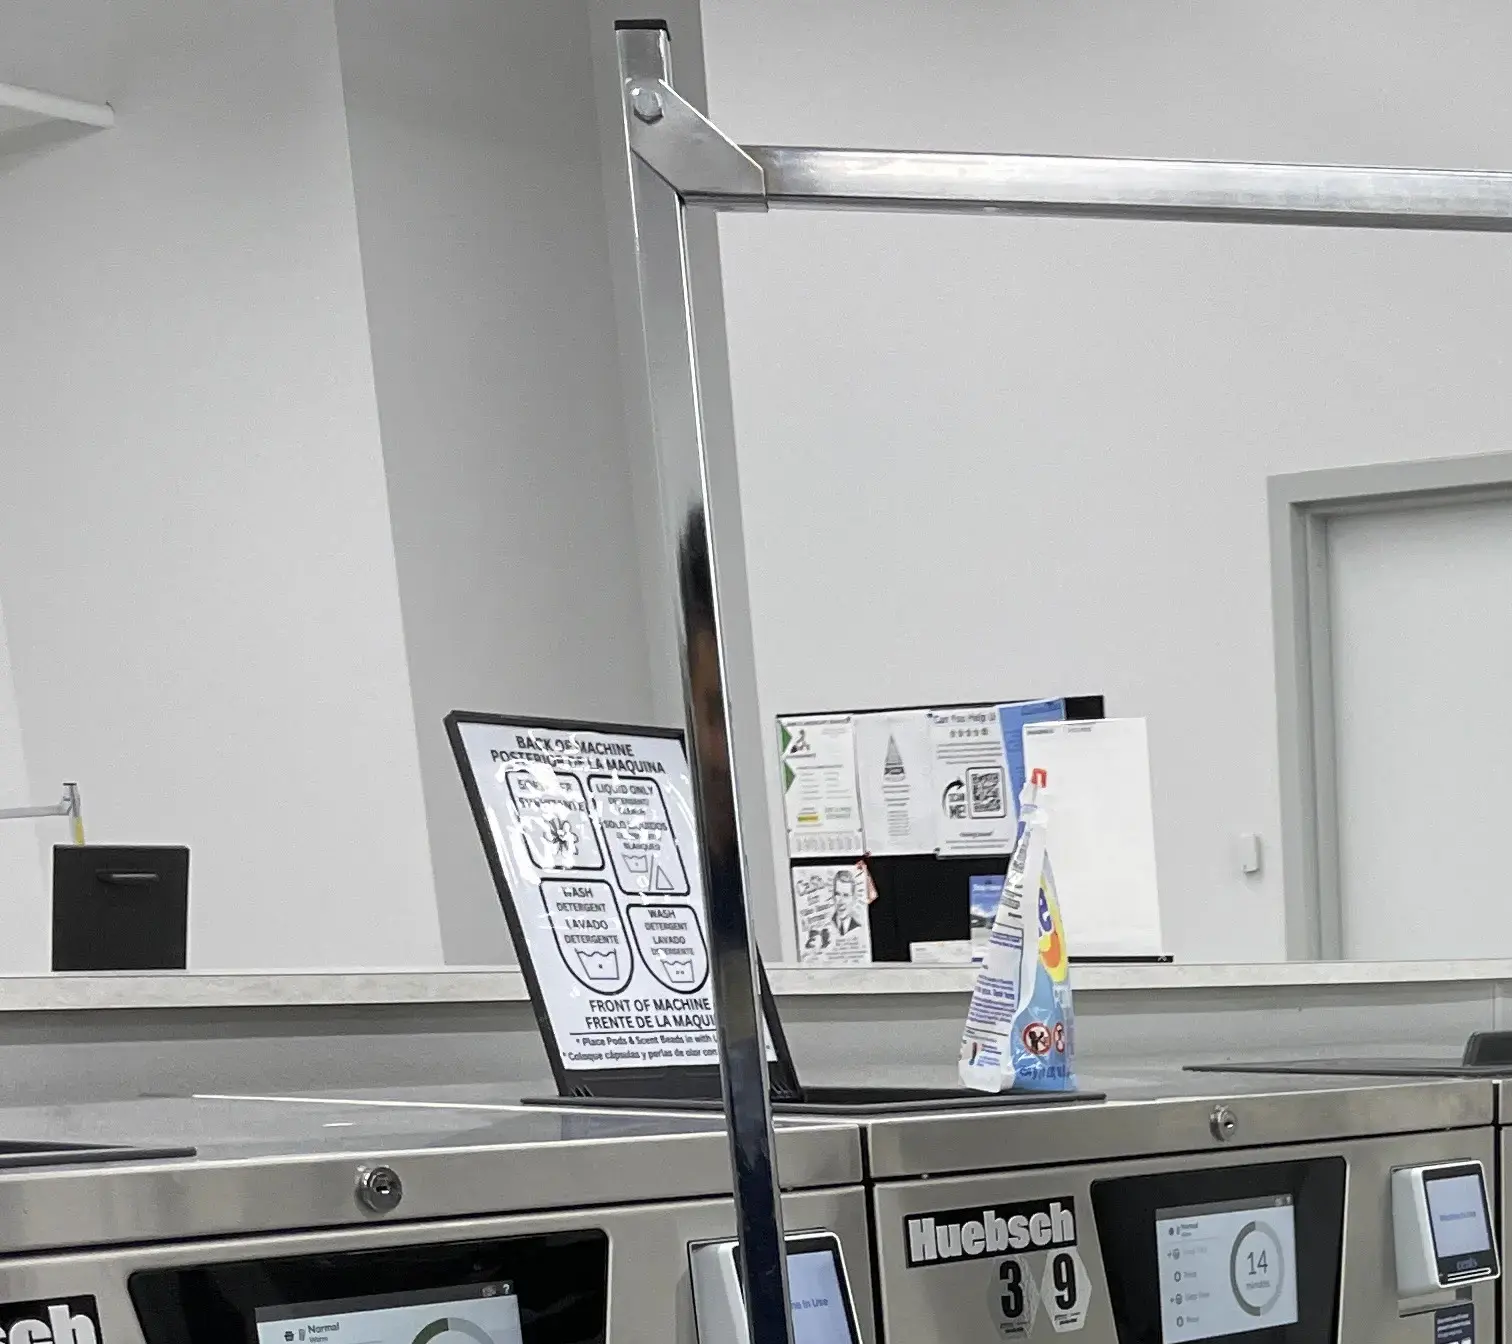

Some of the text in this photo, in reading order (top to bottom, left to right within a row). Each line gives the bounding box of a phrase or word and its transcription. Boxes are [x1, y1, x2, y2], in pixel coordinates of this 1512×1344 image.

[589, 999, 711, 1012] FRONT OF MACHINE
[585, 1015, 715, 1030] FRENTE DE LA MAQUI
[908, 1202, 1075, 1262] Huebsch
[1247, 1249, 1268, 1275] 14
[1000, 1252, 1077, 1319] 39
[308, 1322, 340, 1334] Normal
